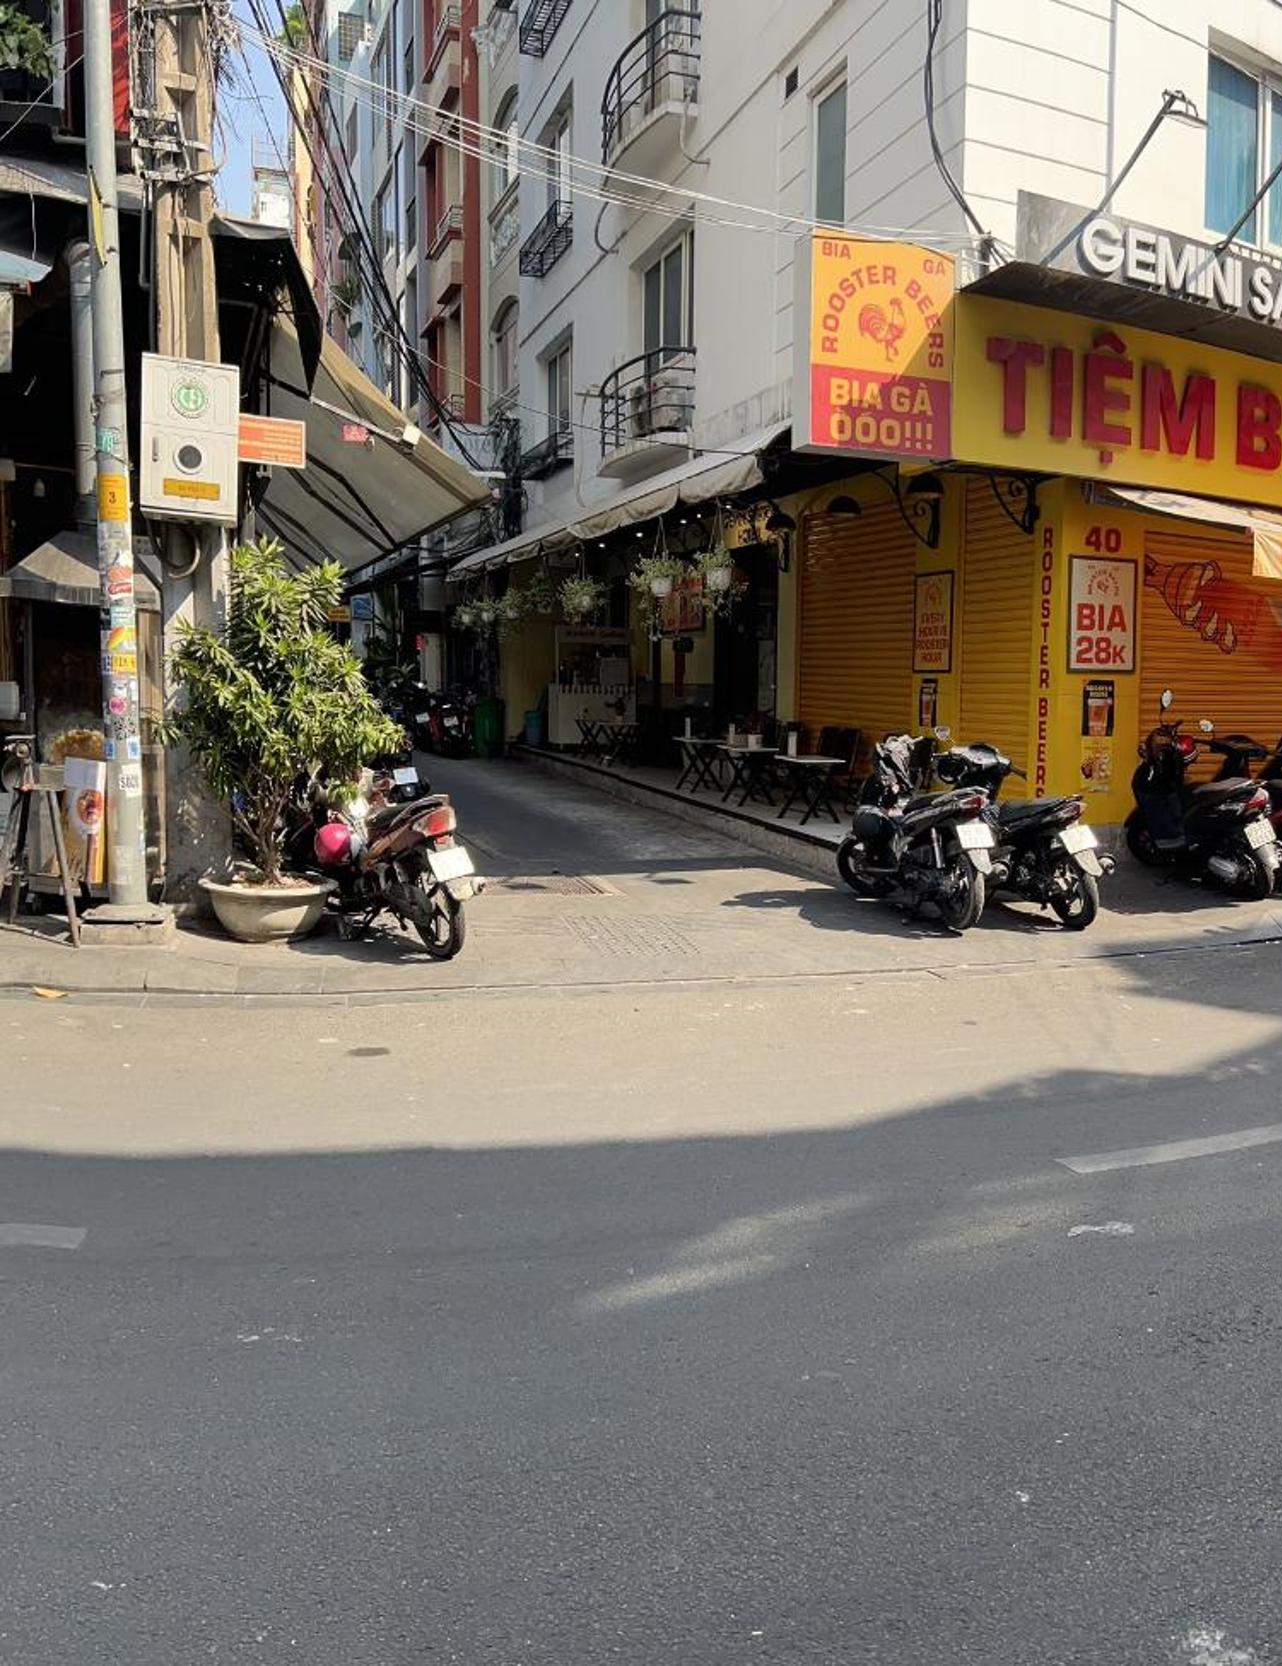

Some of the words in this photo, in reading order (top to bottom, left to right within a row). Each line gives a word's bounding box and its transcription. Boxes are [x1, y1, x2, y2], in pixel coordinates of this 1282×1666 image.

[821, 240, 852, 260] BIA
[1081, 218, 1243, 308] GEMINI
[821, 264, 897, 354] ROOSTER
[904, 279, 945, 370] BEERS
[829, 377, 883, 409] BIA
[890, 383, 933, 417] GÀ
[986, 328, 1217, 466] TIỆM
[1084, 526, 1121, 553] 40
[1040, 527, 1054, 690] ROOSTER
[1077, 603, 1127, 632] BIA
[1076, 636, 1125, 664] 28K
